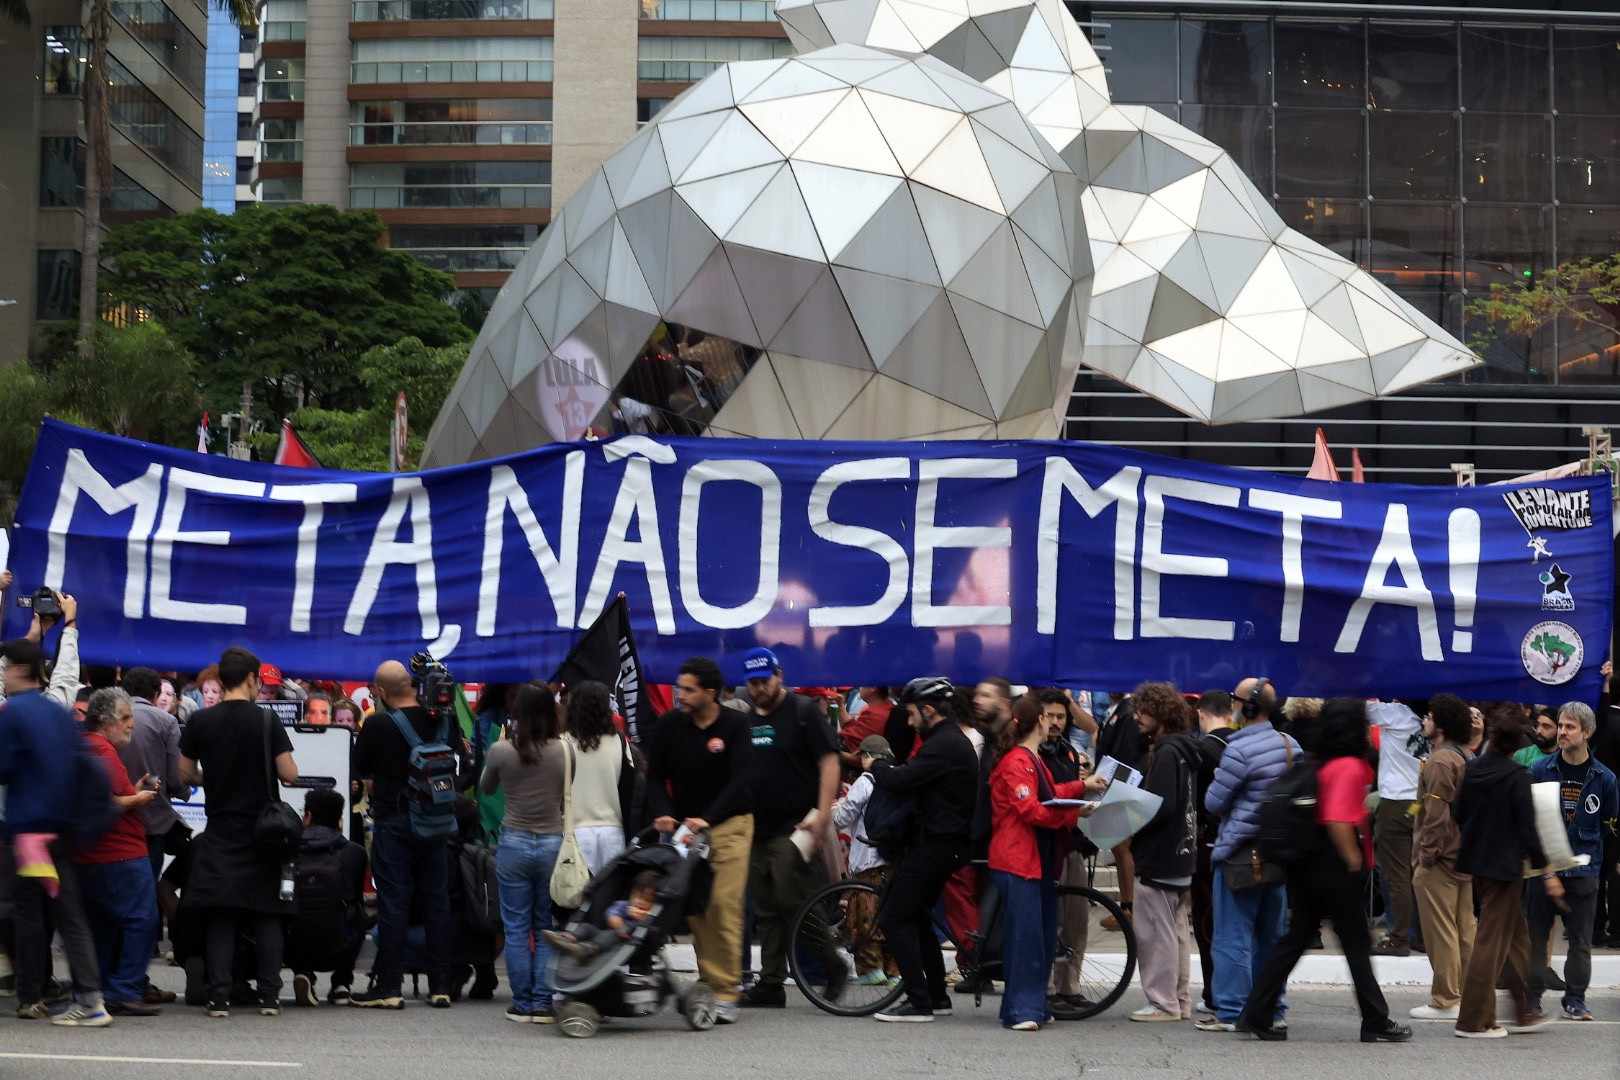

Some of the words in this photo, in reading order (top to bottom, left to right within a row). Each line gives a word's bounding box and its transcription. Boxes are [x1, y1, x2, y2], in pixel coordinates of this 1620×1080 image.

[543, 358, 601, 387] LULA
[564, 402, 587, 428] 13
[1507, 488, 1590, 511] LEVANTE
[1520, 503, 1572, 519] POPULAR
[1575, 508, 1590, 519] DA
[1523, 514, 1592, 530] JUVENTUDE
[44, 448, 461, 660] META,
[476, 434, 782, 637] NÃO
[809, 457, 1018, 628] SE
[1037, 456, 1481, 662] META!
[1543, 597, 1573, 605] BRASIL
